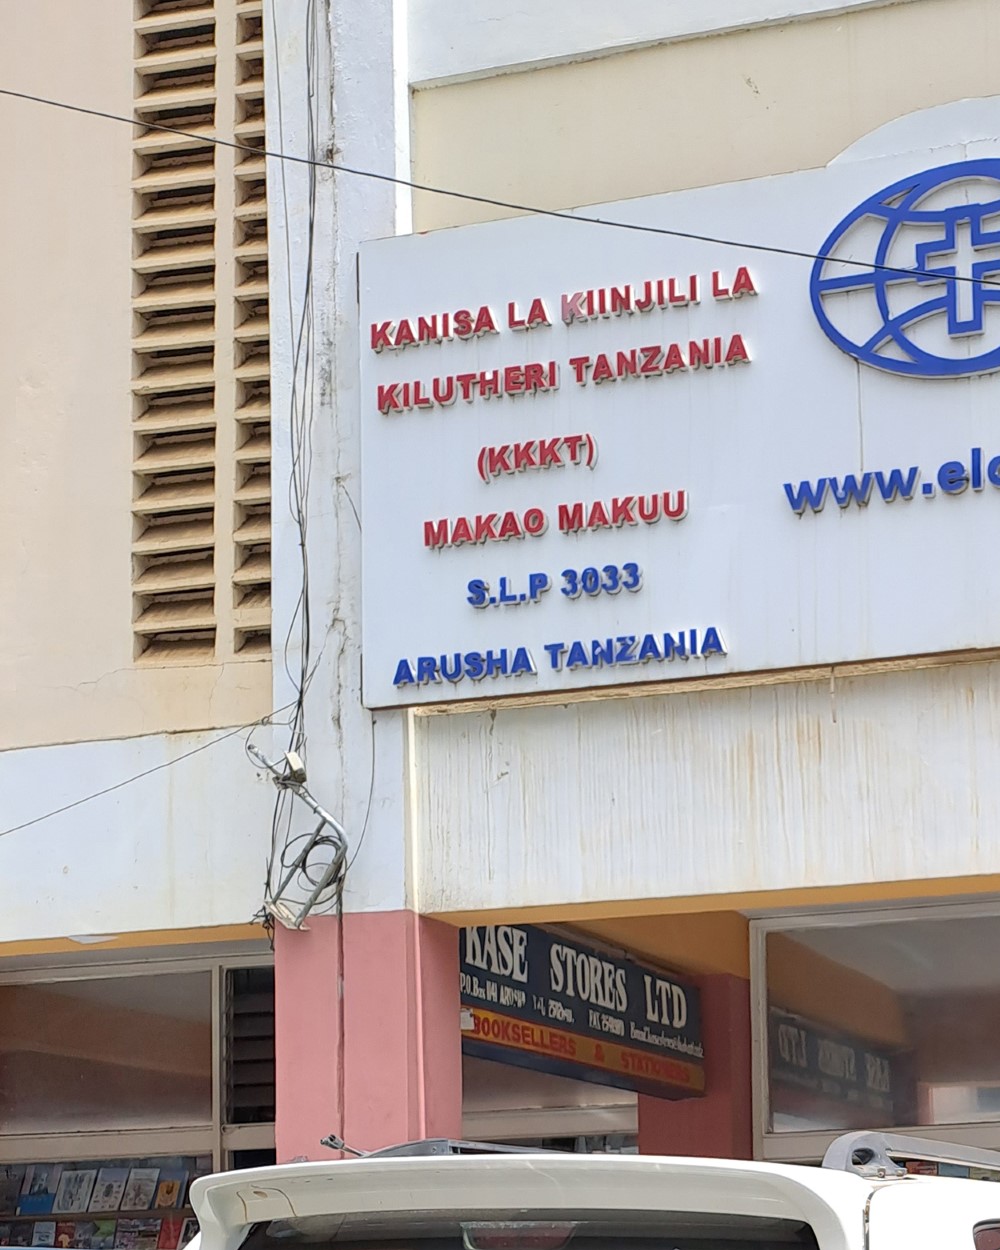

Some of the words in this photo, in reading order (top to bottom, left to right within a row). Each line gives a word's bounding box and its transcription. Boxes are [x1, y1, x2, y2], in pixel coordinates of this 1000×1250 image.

[371, 306, 497, 351] KANISA
[508, 298, 548, 330] LA
[562, 274, 698, 323] KIINJILI
[712, 267, 755, 299] LA
[377, 361, 557, 414] KILUTHERI
[569, 334, 749, 385] TANZANIA
[477, 434, 596, 482] (KKKT)
[424, 507, 545, 548] MAKAO
[558, 490, 686, 532] MAKUU
[466, 571, 549, 607] S.L.P
[560, 562, 641, 597] 3033
[392, 646, 531, 686] ARUSHA
[543, 626, 723, 670] TANZANIA
[465, 925, 529, 984] KASE
[550, 943, 628, 1013] STORES
[643, 974, 688, 1029] LTD
[473, 1014, 577, 1058] BOOKSELLERS
[594, 1043, 605, 1063] &
